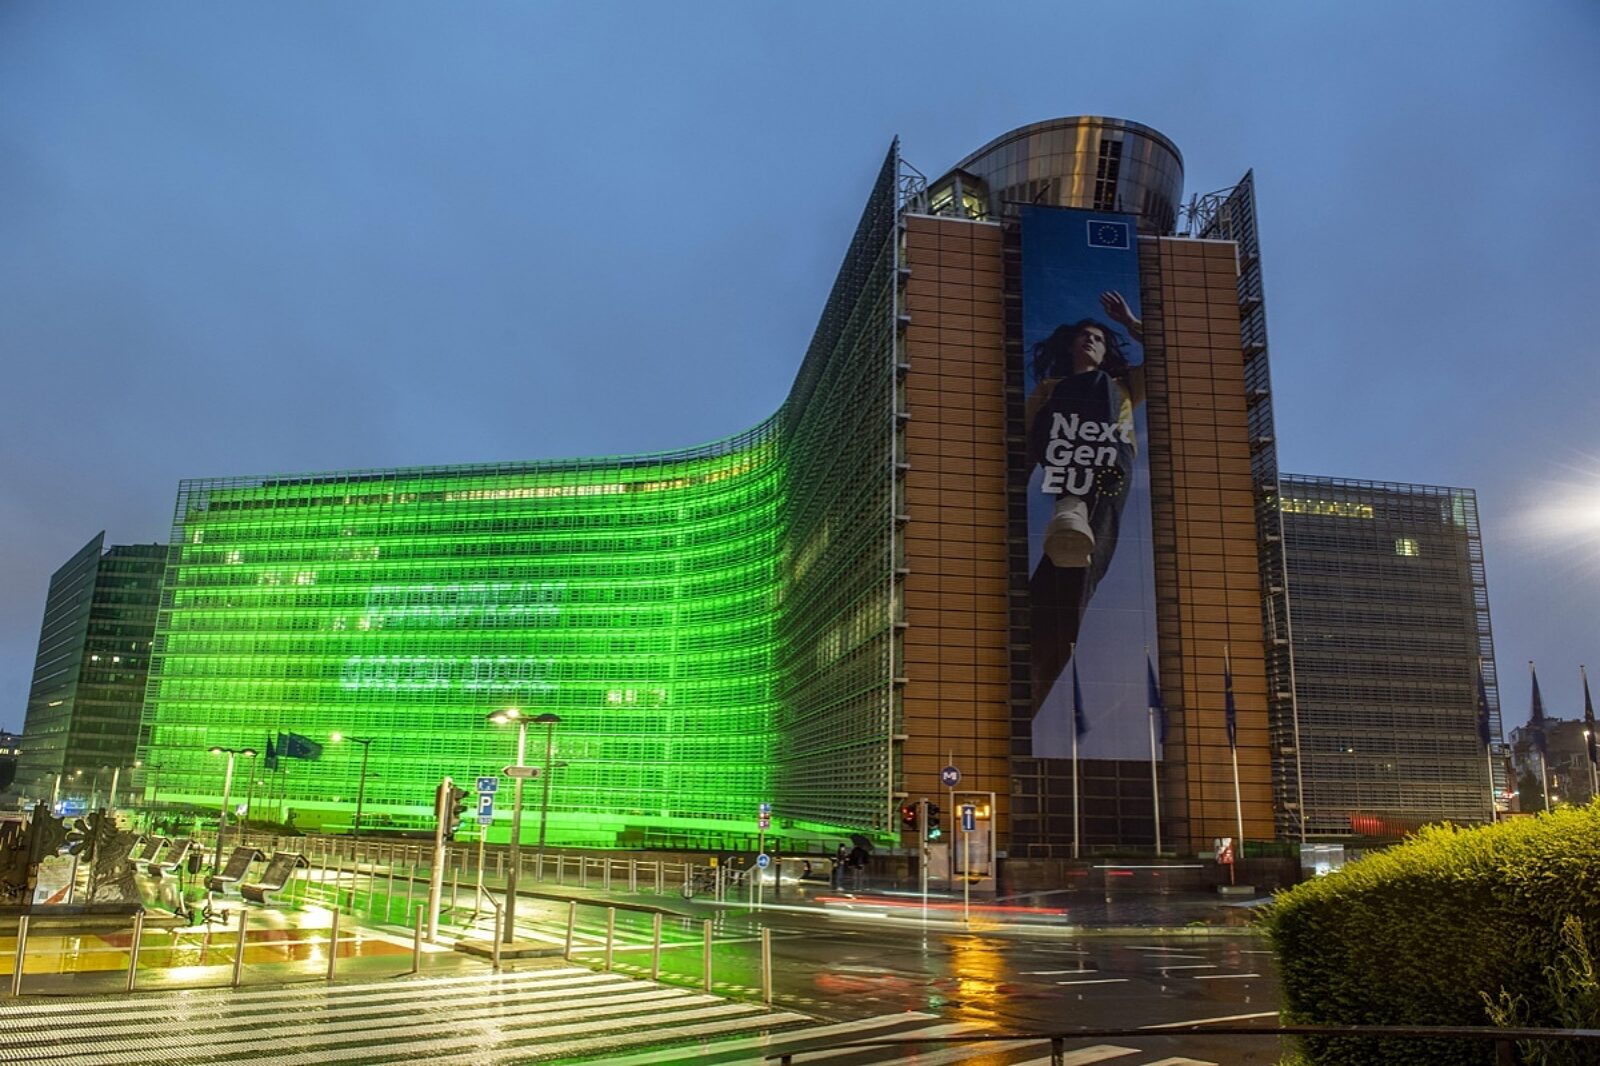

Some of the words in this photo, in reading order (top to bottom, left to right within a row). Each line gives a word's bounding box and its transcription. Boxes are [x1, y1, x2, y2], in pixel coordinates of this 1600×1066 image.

[1050, 412, 1132, 443] Next
[1045, 439, 1118, 466] Gen
[1041, 466, 1094, 495] EU
[480, 796, 492, 813] P
